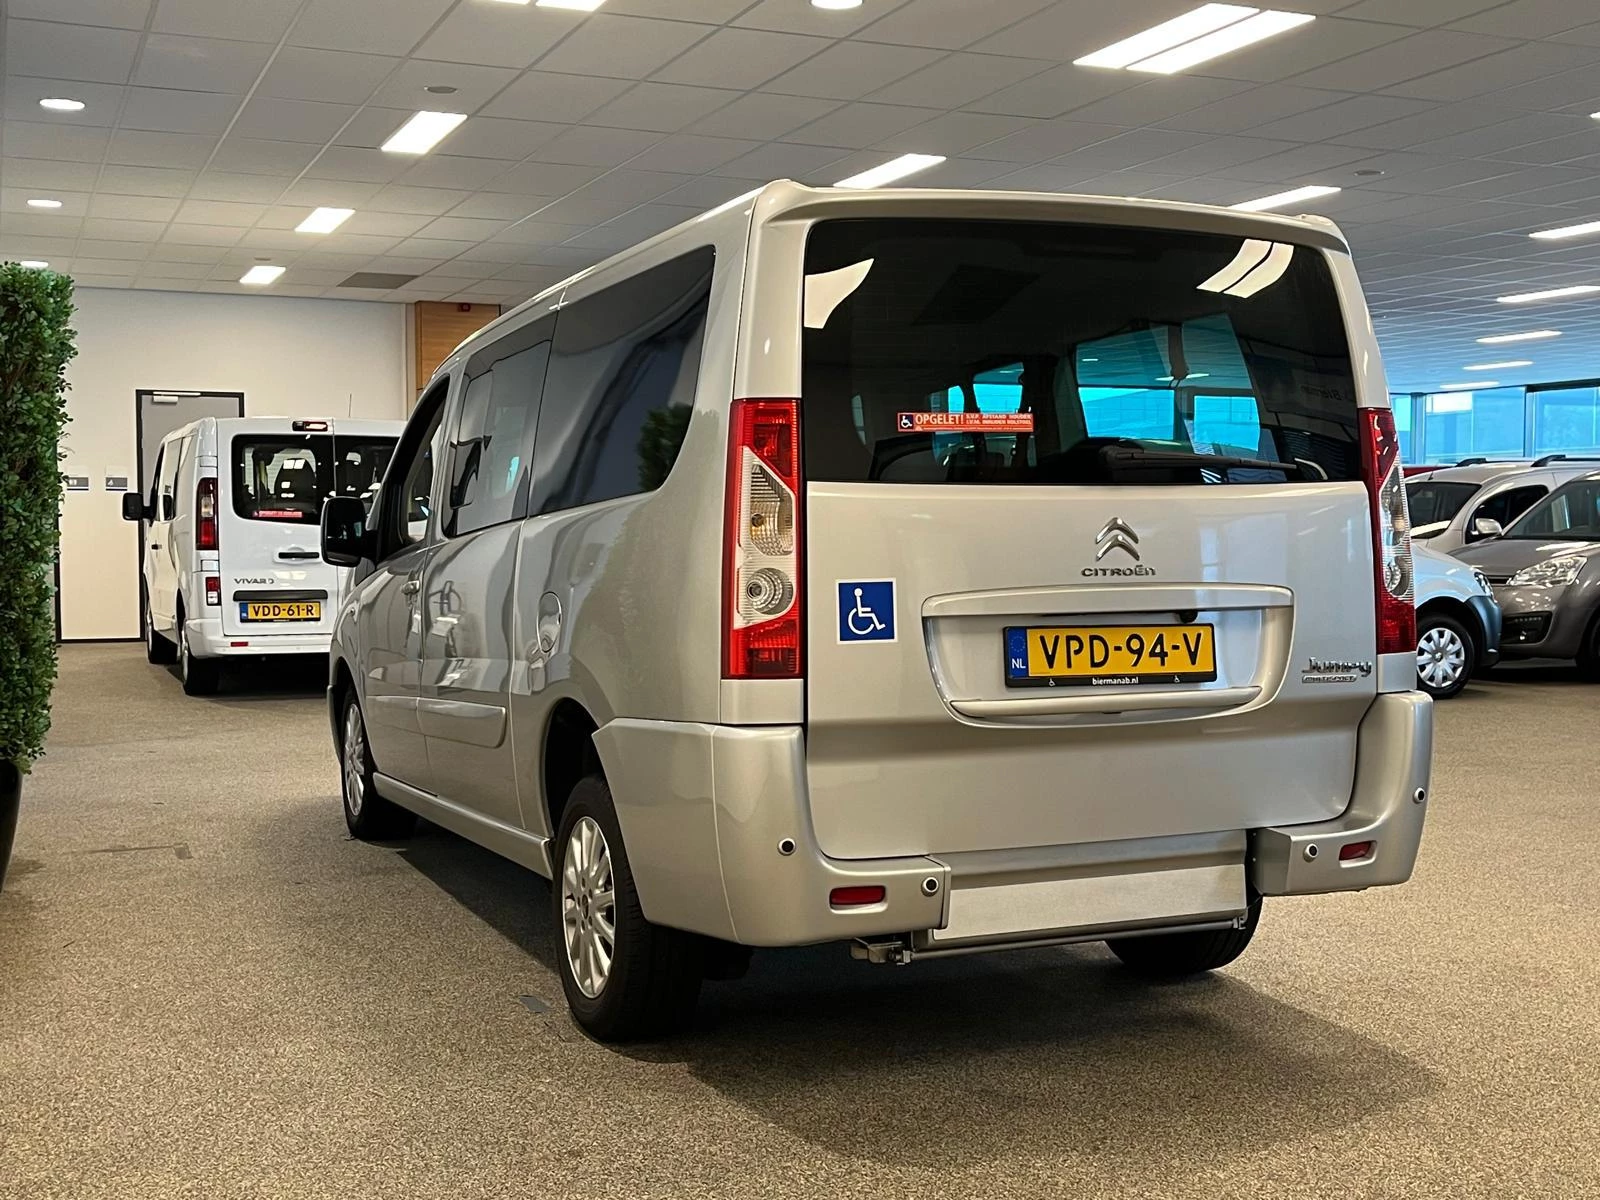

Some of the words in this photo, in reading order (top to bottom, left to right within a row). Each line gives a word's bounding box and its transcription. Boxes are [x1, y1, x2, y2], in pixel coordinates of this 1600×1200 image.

[915, 413, 964, 425] OPGELET!
[253, 604, 314, 617] VDD-61-R
[1011, 657, 1026, 669] NL
[1039, 632, 1202, 669] VPD-94-V
[1092, 676, 1139, 686] biermanab.nl
